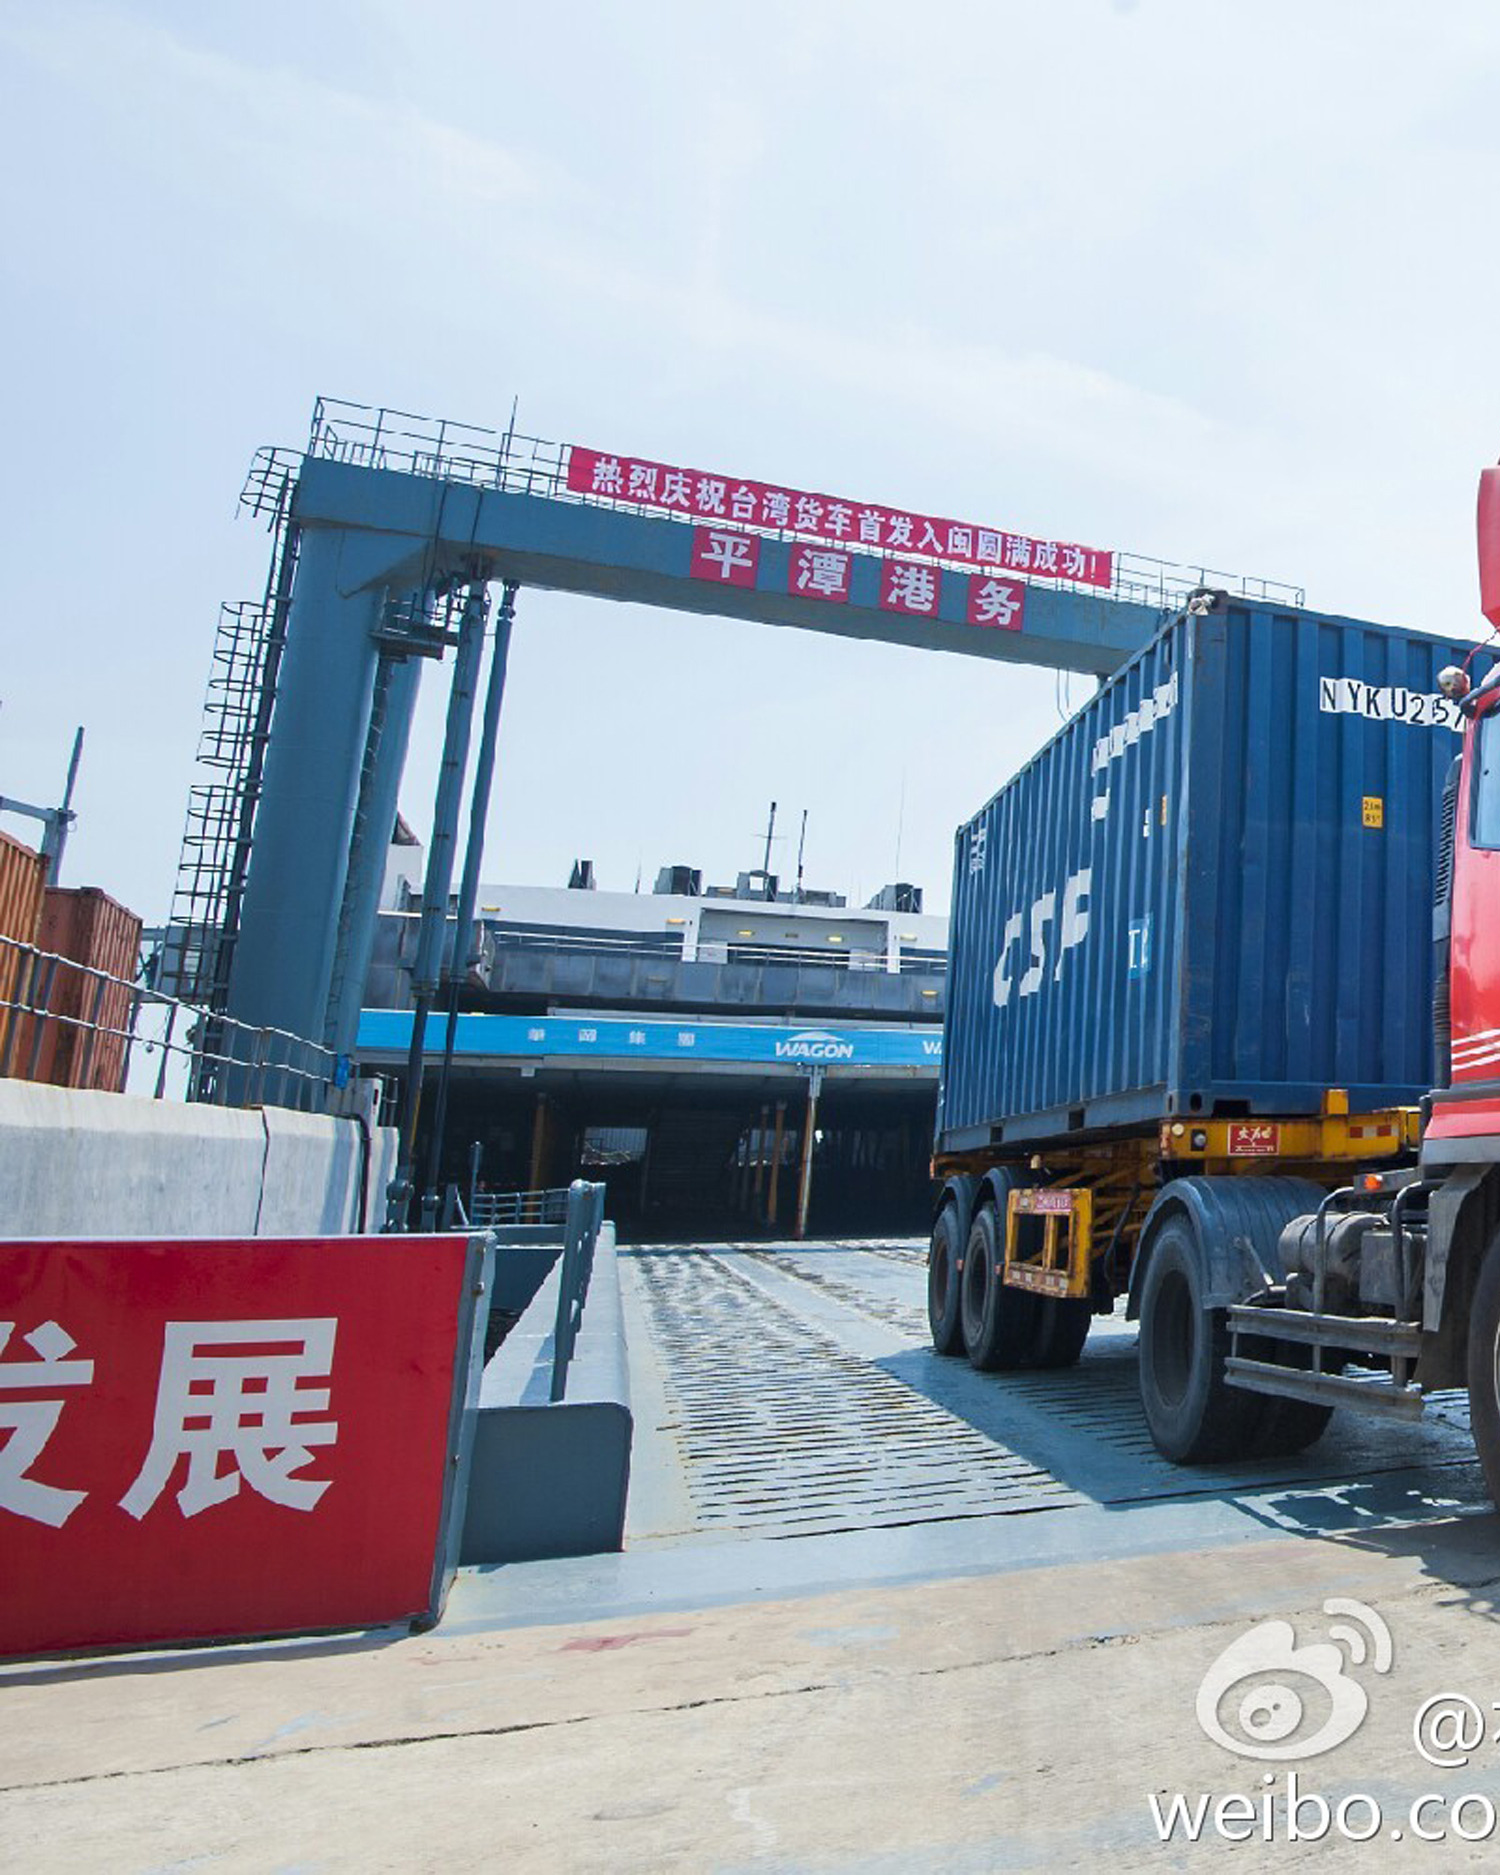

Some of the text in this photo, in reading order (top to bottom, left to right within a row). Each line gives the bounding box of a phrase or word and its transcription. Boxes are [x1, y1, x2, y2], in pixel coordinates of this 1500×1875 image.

[700, 532, 1021, 626] 平潭港务
[775, 1041, 854, 1058] WAGON
